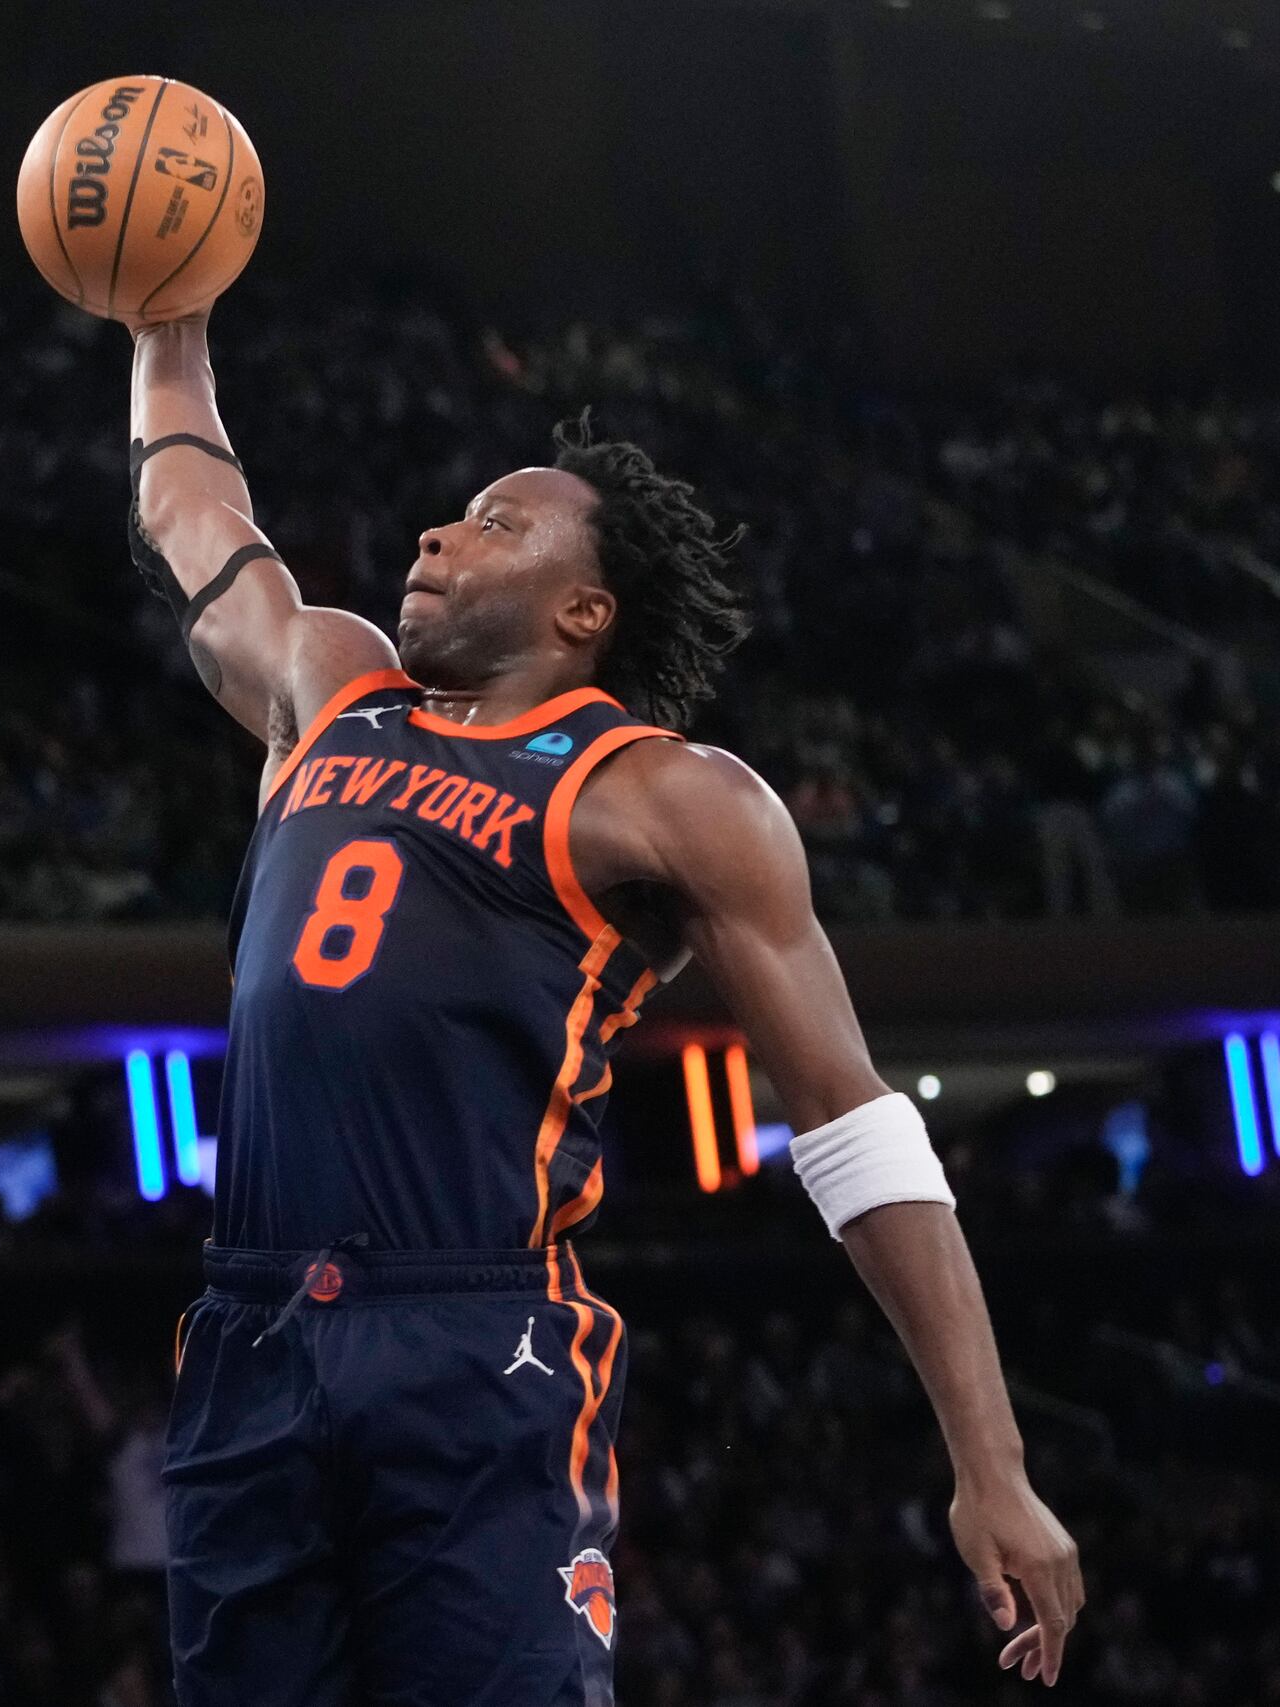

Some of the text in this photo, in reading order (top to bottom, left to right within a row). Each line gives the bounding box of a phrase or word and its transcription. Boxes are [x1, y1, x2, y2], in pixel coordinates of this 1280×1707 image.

[67, 86, 146, 230] Wilson
[280, 756, 536, 869] NEW YORK
[509, 750, 564, 767] sphere
[291, 836, 408, 992] 8
